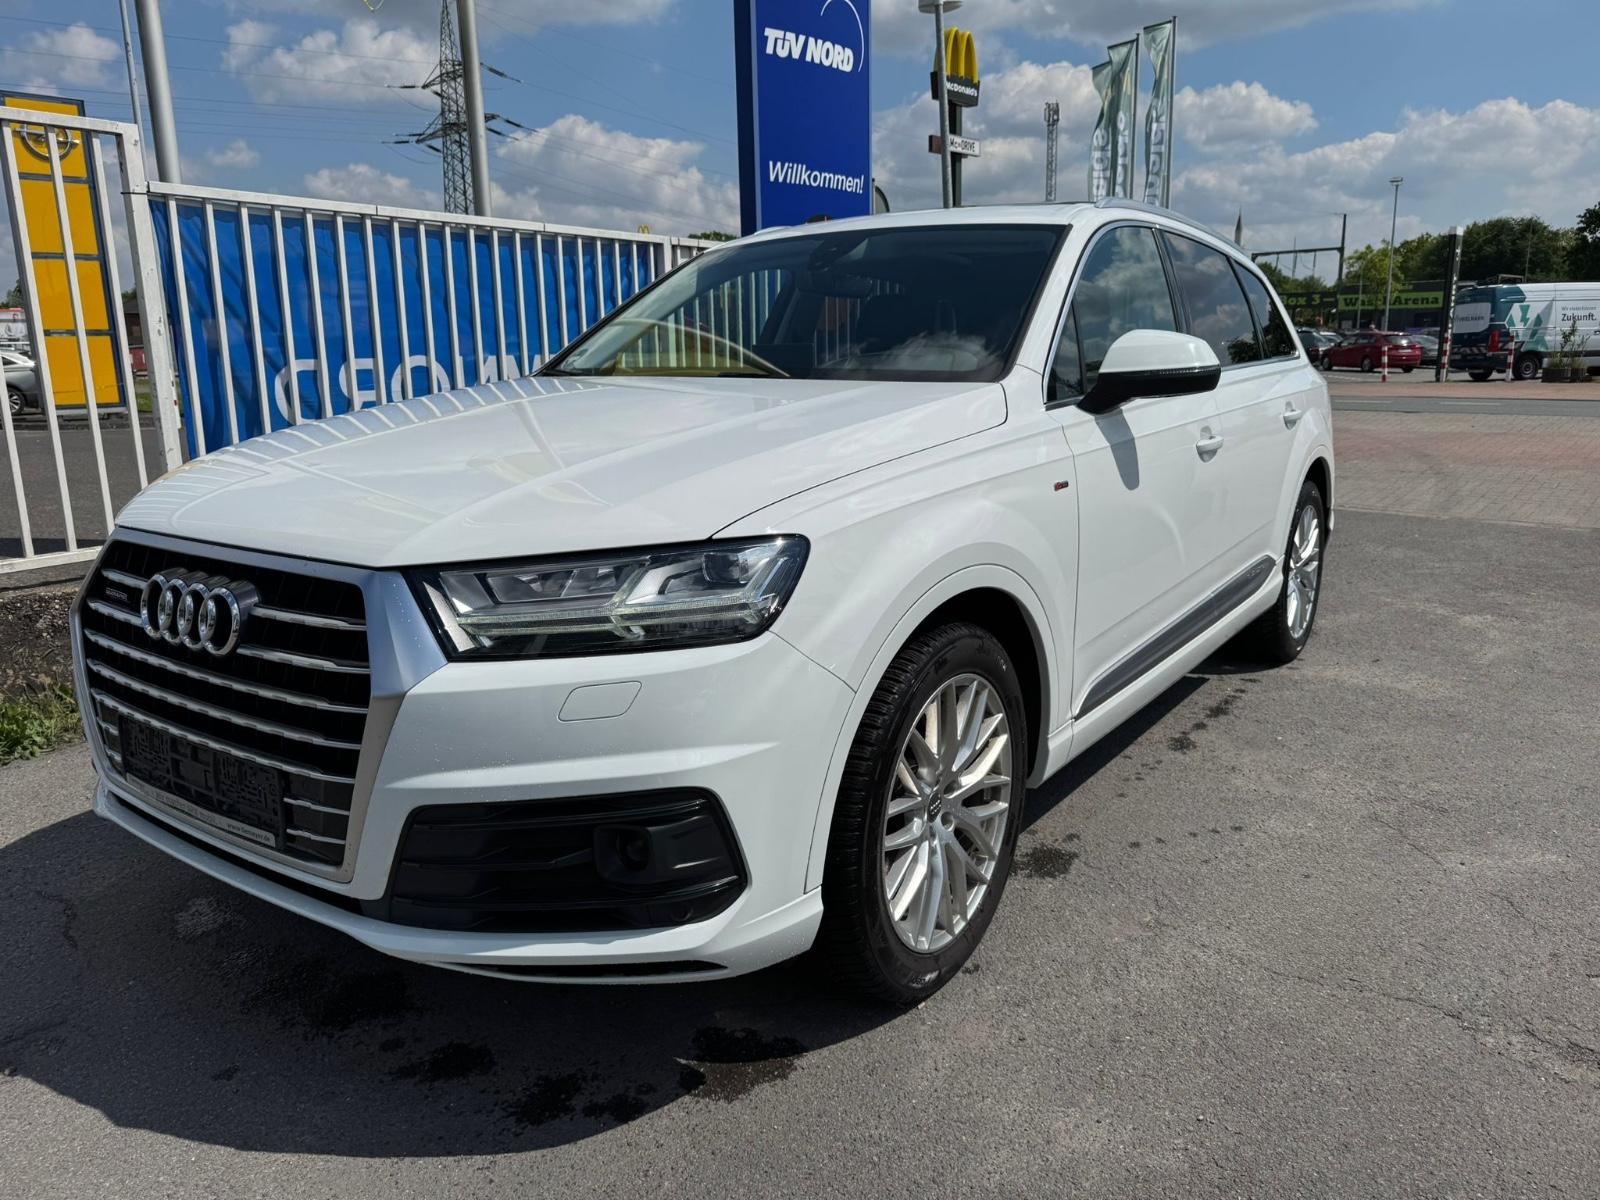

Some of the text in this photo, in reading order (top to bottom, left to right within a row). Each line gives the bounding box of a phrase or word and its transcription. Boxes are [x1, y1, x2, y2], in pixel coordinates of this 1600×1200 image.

[764, 27, 854, 72] TÜV NORD
[769, 160, 864, 194] Willkommen!
[1561, 312, 1597, 322] Zukunft.
